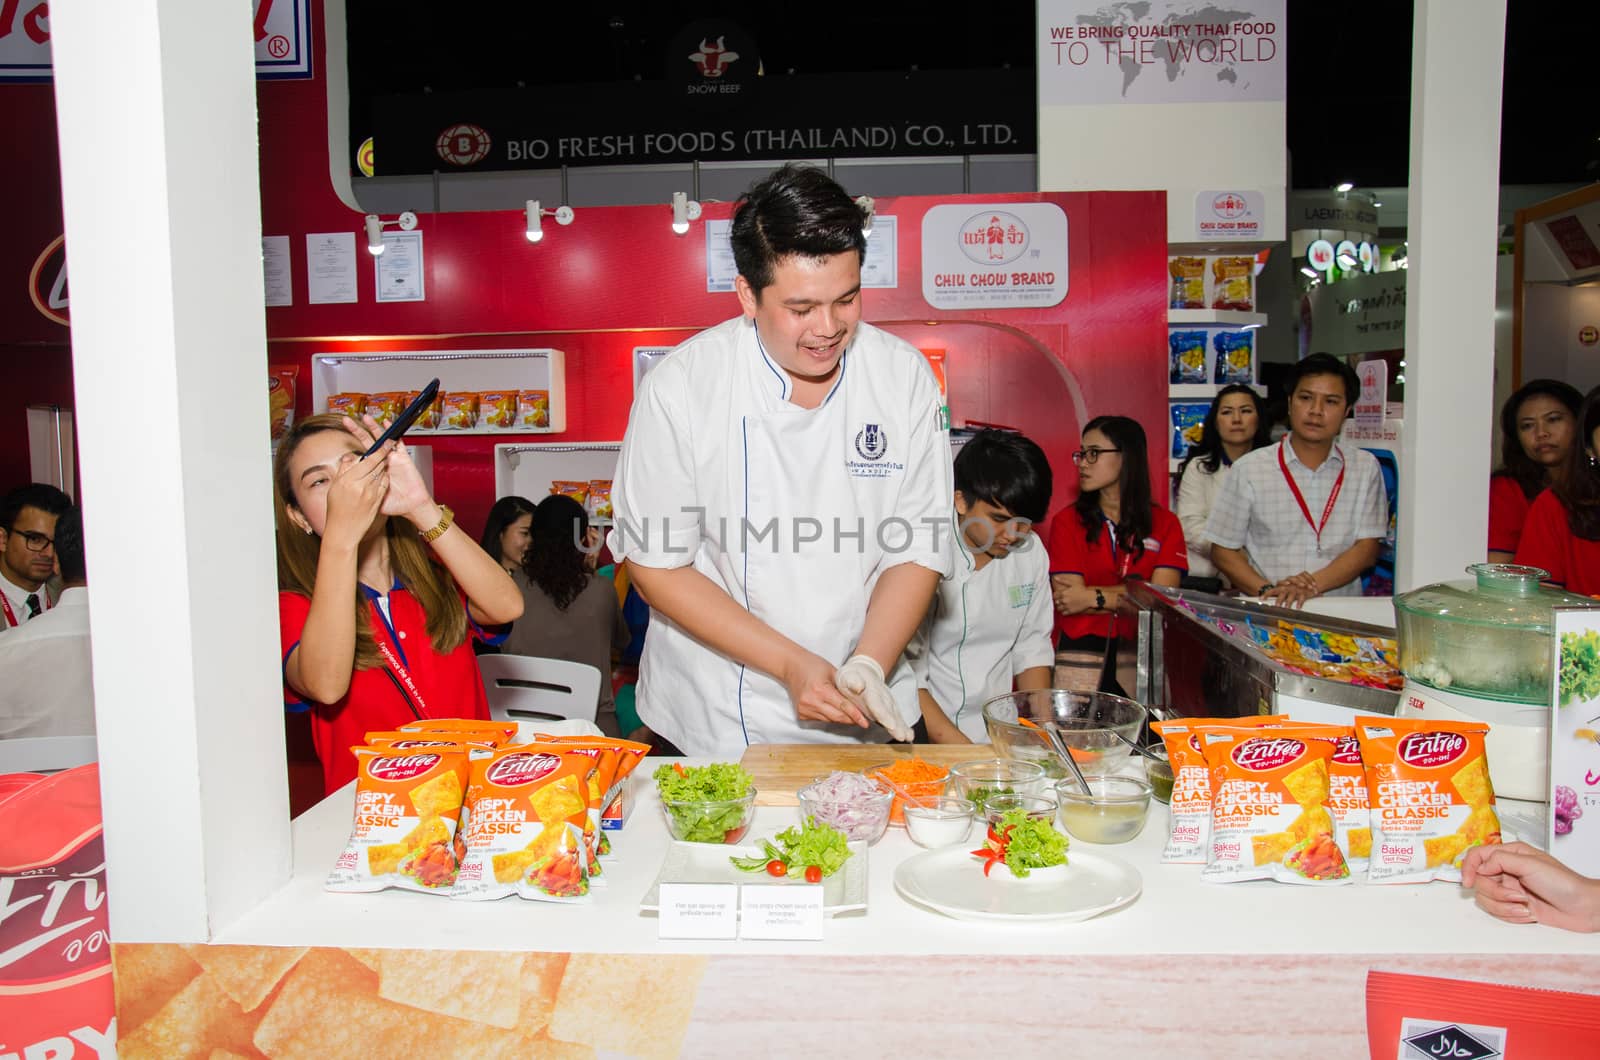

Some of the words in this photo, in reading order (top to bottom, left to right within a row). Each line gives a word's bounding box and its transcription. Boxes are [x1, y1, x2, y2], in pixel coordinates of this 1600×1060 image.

[1050, 27, 1074, 39] WE
[1078, 25, 1124, 39] BRING
[1128, 23, 1192, 40] QUALITY
[1195, 23, 1230, 36] THAI
[1233, 22, 1276, 35] FOOD
[1050, 41, 1089, 66] TO
[1099, 40, 1156, 65] THE
[1167, 37, 1277, 63] WORLD
[720, 84, 741, 94] BEEF
[507, 139, 549, 161] BIO
[558, 135, 634, 158] FRESH
[644, 130, 736, 154] FOODS
[744, 126, 897, 153] (THAILAND)
[905, 124, 955, 148] CO.,
[963, 123, 1018, 146] LTD.
[934, 273, 966, 288] CHIU
[970, 272, 1008, 287] CHOW
[1011, 271, 1056, 286] BRAND
[405, 677, 415, 691] Best
[1405, 733, 1462, 761] Entrée
[1377, 781, 1439, 796] CRISPY
[1172, 790, 1212, 803] CLAS
[1379, 793, 1453, 808] CHICKEN
[1214, 805, 1281, 819] CLASSIC
[1382, 806, 1449, 820] CLASSIC
[1381, 844, 1414, 855] Baked
